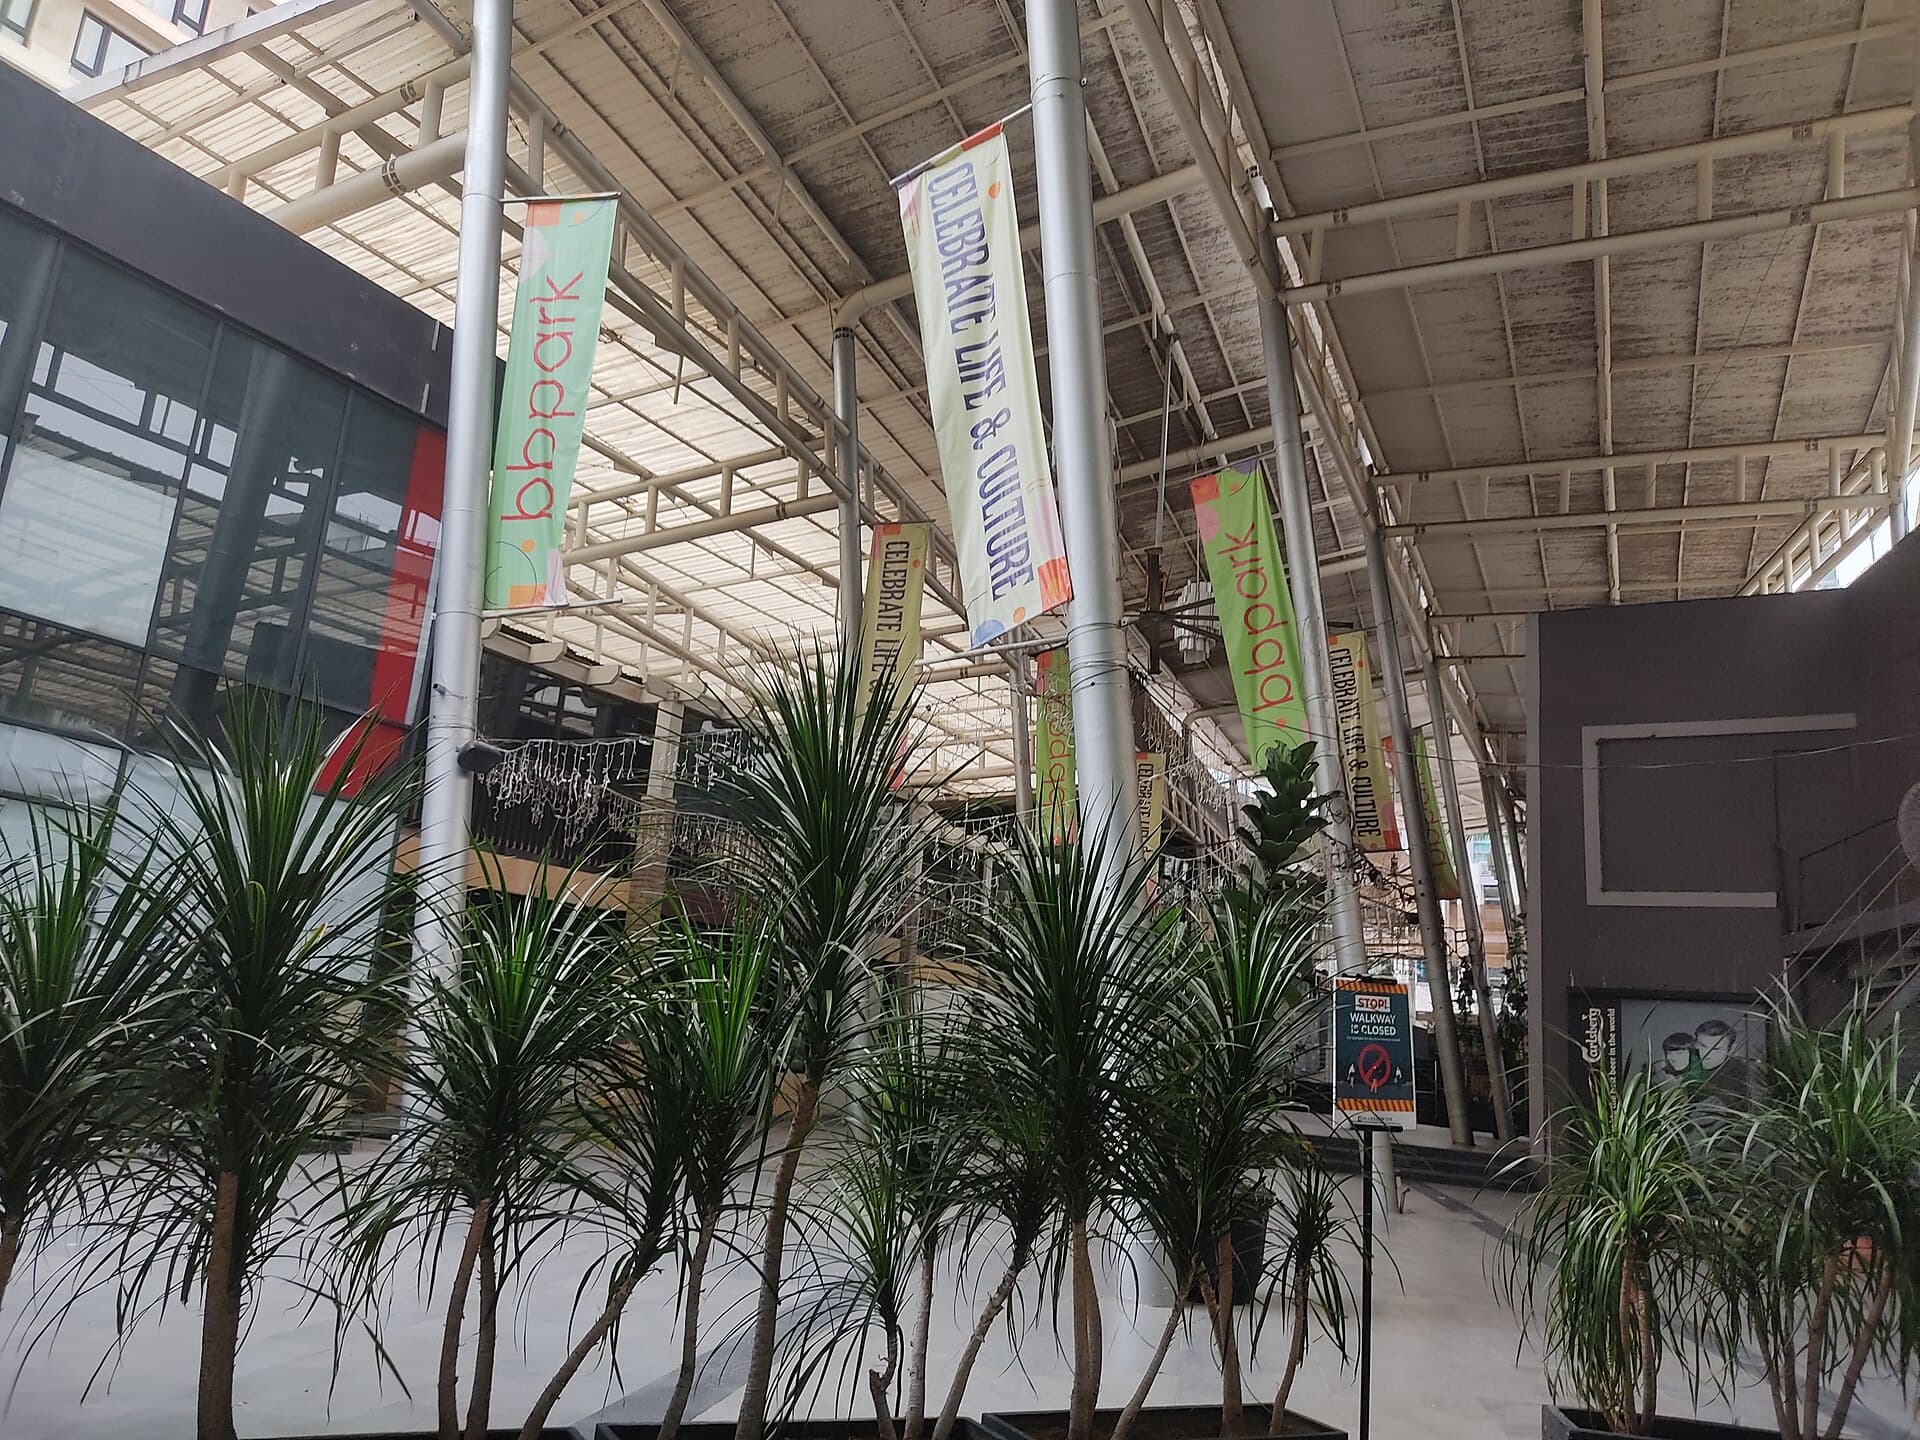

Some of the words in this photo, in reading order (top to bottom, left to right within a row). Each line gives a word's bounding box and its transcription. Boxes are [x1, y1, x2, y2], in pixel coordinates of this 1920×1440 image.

[928, 160, 998, 335] CELEBRATE
[953, 335, 1006, 411] LIFE
[501, 271, 584, 521] bbpark
[970, 407, 1011, 450] &
[976, 443, 1035, 601] CULTURE
[876, 541, 910, 632] CELEBRATE
[1217, 522, 1294, 713] bbpark
[1330, 648, 1361, 723] CELEBRATE
[1343, 725, 1367, 756] LIFE
[1348, 759, 1369, 772] &
[1351, 776, 1382, 837] CULTURE
[1350, 1012, 1396, 1024] WALKWAY
[1357, 999, 1387, 1009] STOP!
[1607, 1008, 1616, 1032] world
[1351, 1025, 1359, 1034] IS
[1361, 1025, 1396, 1036] CLOSED
[1582, 1008, 1604, 1062] Carlsberg
[1608, 1033, 1616, 1047] the
[1608, 1047, 1617, 1056] in
[1608, 1058, 1617, 1076] beer
